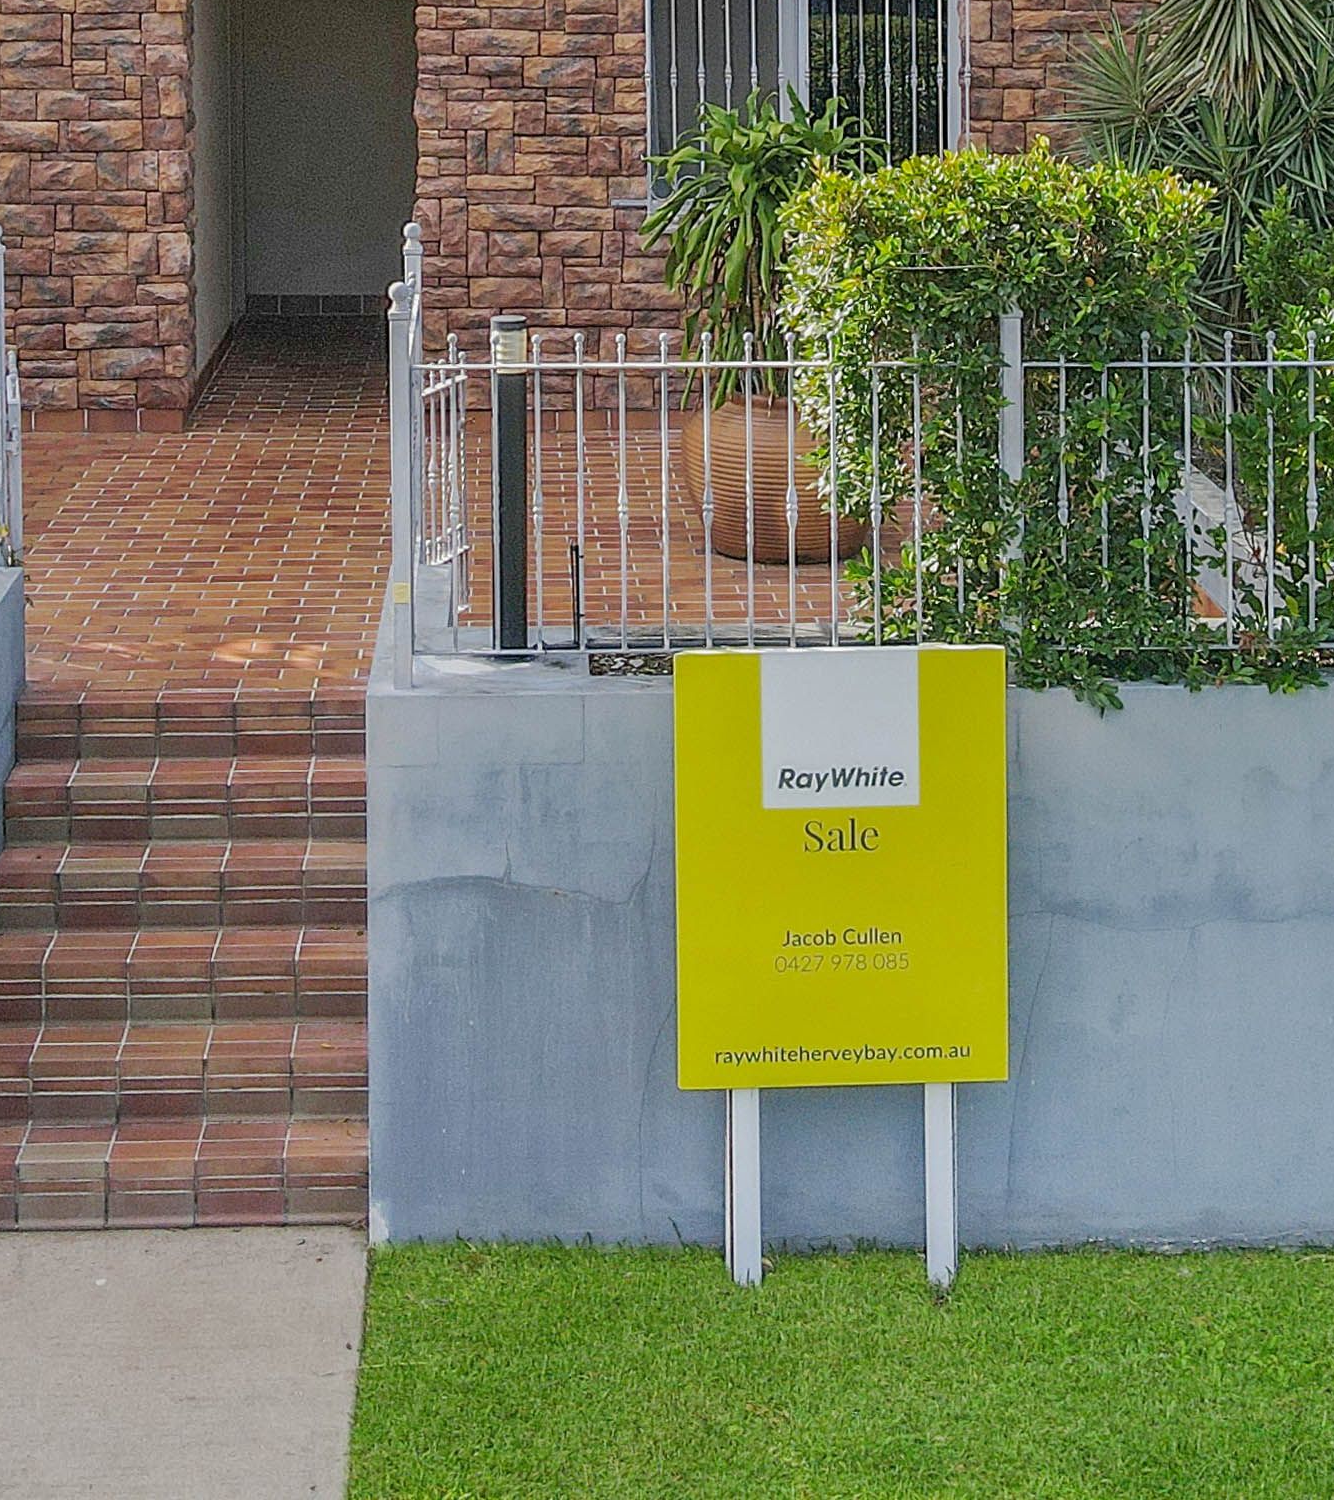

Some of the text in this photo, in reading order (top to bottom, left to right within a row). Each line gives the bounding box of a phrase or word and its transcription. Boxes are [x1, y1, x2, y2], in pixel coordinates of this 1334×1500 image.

[804, 818, 879, 853] Sale
[782, 927, 902, 948] Jacob Cullen
[775, 953, 909, 973] 0427 978 085
[715, 1044, 970, 1066] raywhiteherveybay.com.au
